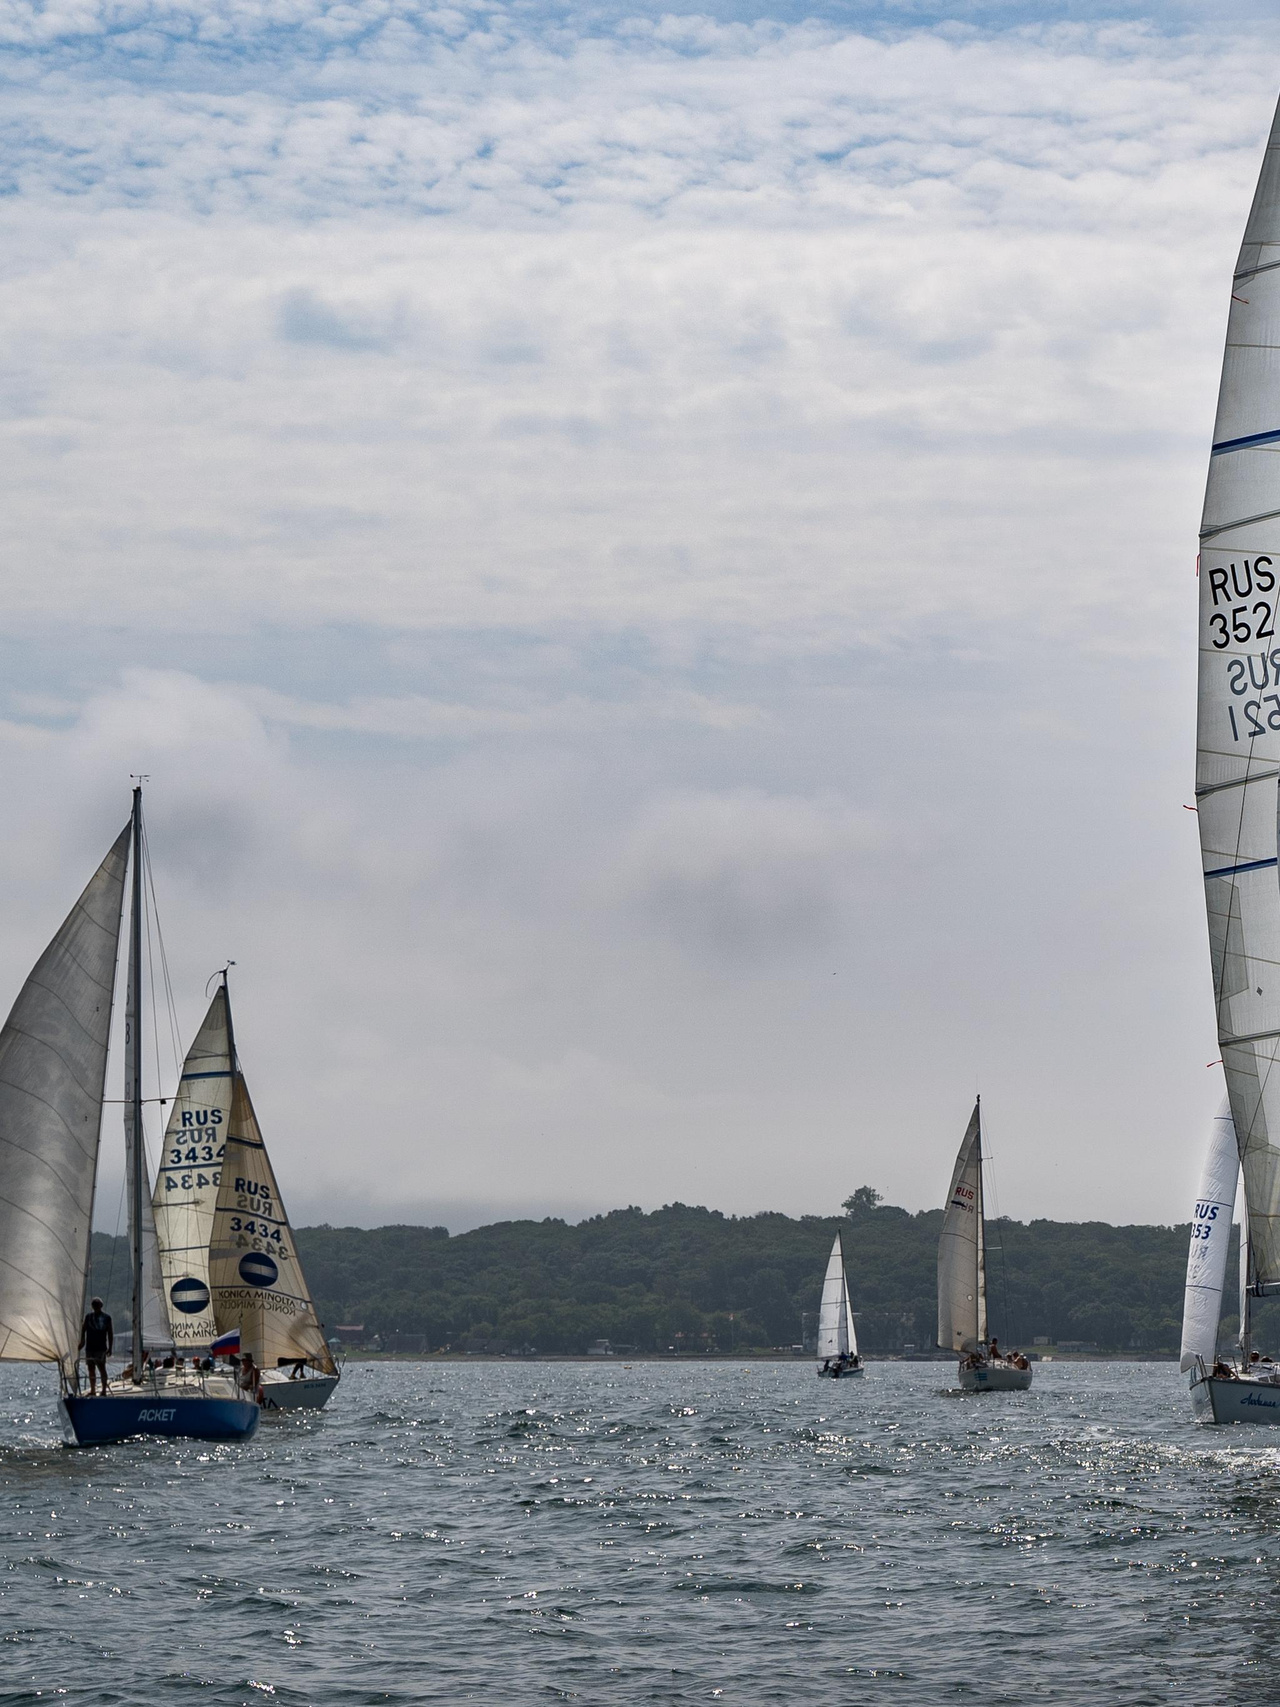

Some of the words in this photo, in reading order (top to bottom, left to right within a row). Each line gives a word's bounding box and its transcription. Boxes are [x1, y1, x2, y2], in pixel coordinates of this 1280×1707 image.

[1208, 556, 1275, 606] RUS
[181, 1109, 223, 1127] RUS
[169, 1144, 226, 1164] 3434
[234, 1177, 271, 1200] RUS
[956, 1187, 974, 1200] RUS
[1194, 1203, 1220, 1220] RUS
[230, 1216, 282, 1243] 3434
[218, 1290, 251, 1299] KONICA
[254, 1290, 296, 1308] MINOLTA
